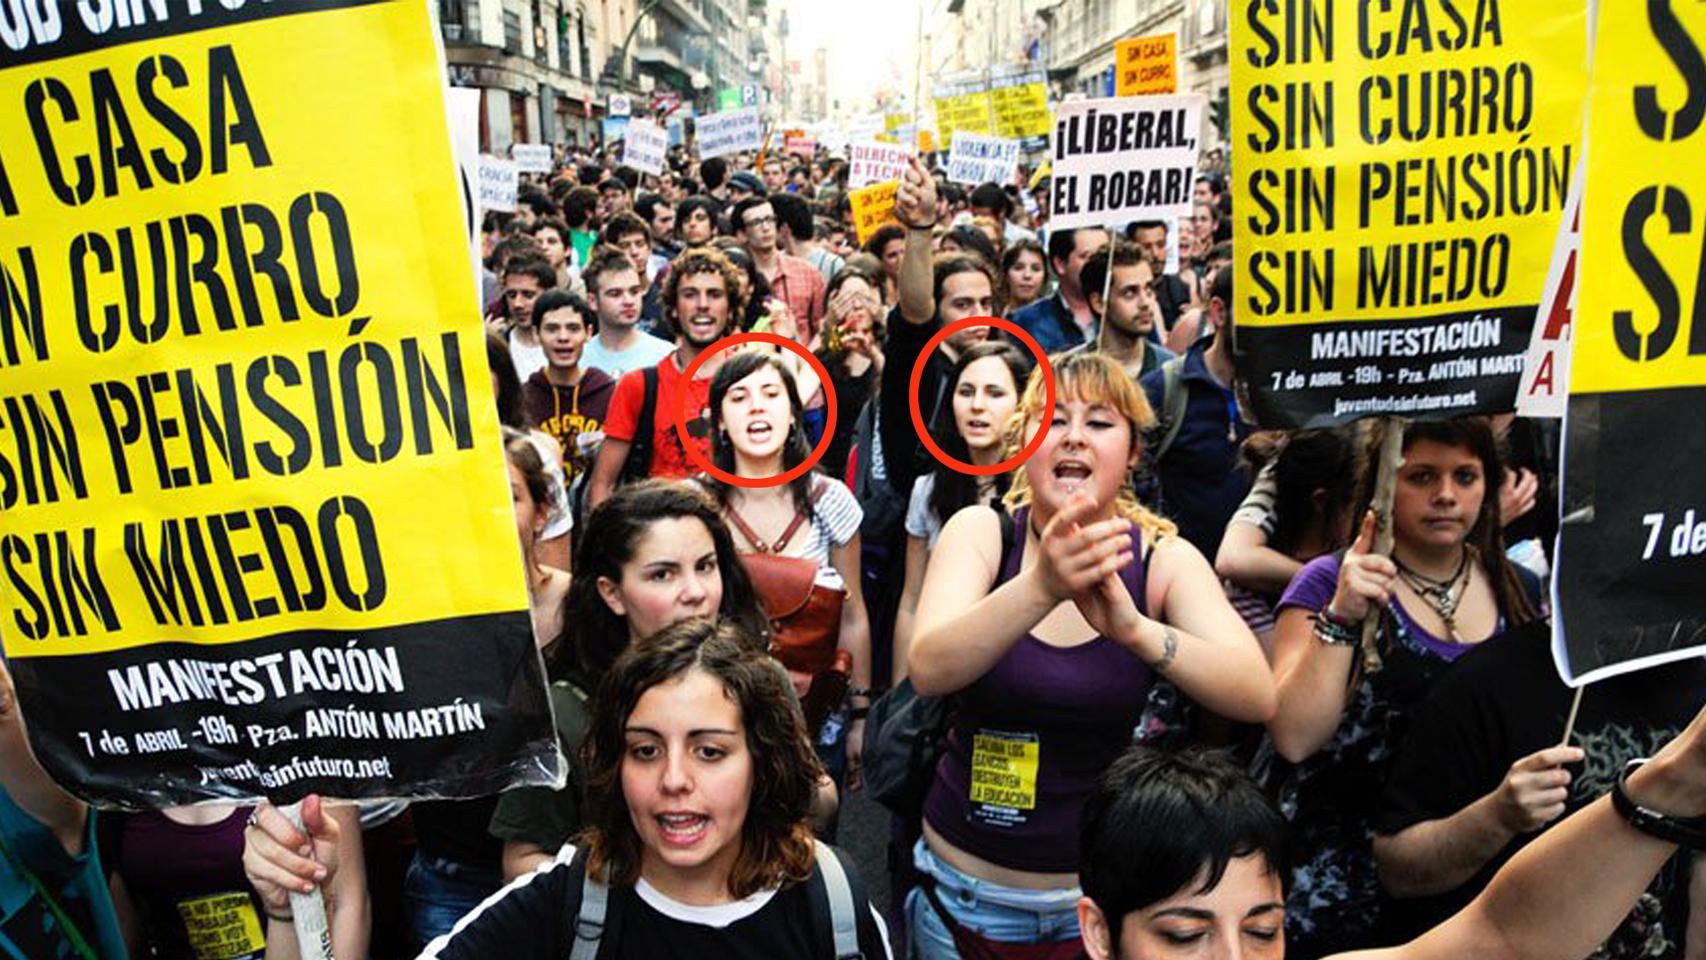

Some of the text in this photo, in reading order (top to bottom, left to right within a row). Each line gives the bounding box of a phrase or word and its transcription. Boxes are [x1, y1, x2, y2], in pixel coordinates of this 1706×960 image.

[1247, 0, 1503, 68] SIN CASA
[24, 45, 272, 206] CASA
[1247, 62, 1533, 153] SIN CURRO
[855, 146, 907, 165] DERECH
[865, 163, 903, 179] TECH
[1248, 166, 1335, 236] SIN
[1359, 134, 1571, 229] PENSIÓN
[1053, 167, 1193, 215] EL ROBAR!
[69, 191, 360, 352] CURRO
[1248, 233, 1510, 316] SIN MIEDO
[1311, 314, 1501, 360] MANIFESTACIÓN
[1271, 372, 1281, 391] 7
[1285, 370, 1304, 389] de
[1309, 374, 1343, 388] ABRIL
[1398, 368, 1424, 384] Pza.
[1428, 357, 1477, 381] ANTÓN
[1481, 354, 1526, 374] MART
[1334, 391, 1476, 417] juventudsinfuturo.net
[1529, 351, 1553, 395] A
[90, 316, 474, 494] PENSIÓN
[2, 495, 388, 641] SIN MIEDO
[1642, 514, 1665, 560] 7
[107, 639, 404, 711] MANIFESTACIÓN
[79, 731, 95, 757] 7
[100, 729, 129, 755] de
[136, 729, 188, 754] ABRIL
[247, 723, 299, 749] Pza.
[304, 704, 379, 739] ANTÓN
[383, 698, 485, 740] MARTÍN
